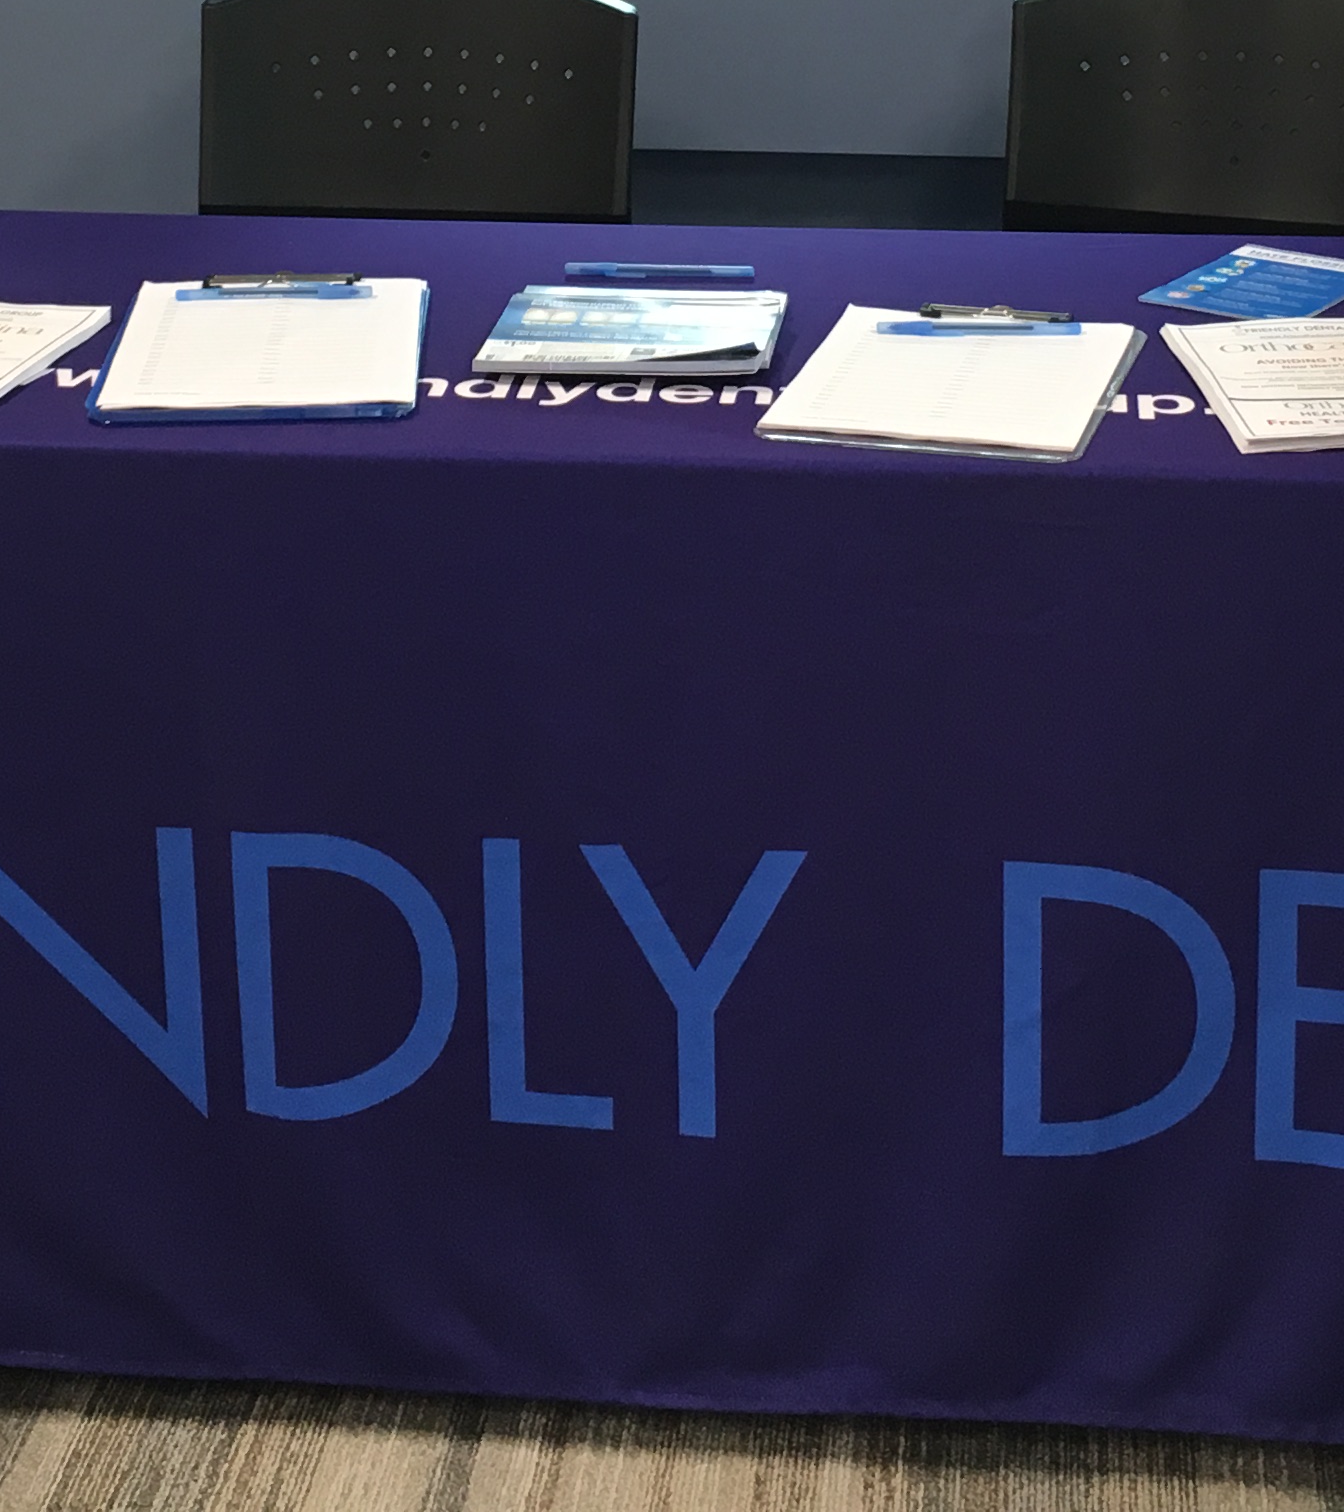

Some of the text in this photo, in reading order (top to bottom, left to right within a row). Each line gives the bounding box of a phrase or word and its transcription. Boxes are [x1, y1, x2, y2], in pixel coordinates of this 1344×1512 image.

[1244, 325, 1300, 334] FRIENDLY
[1256, 357, 1328, 365] AVOIDING
[418, 374, 784, 406] ndlyden
[1266, 417, 1314, 426] Free
